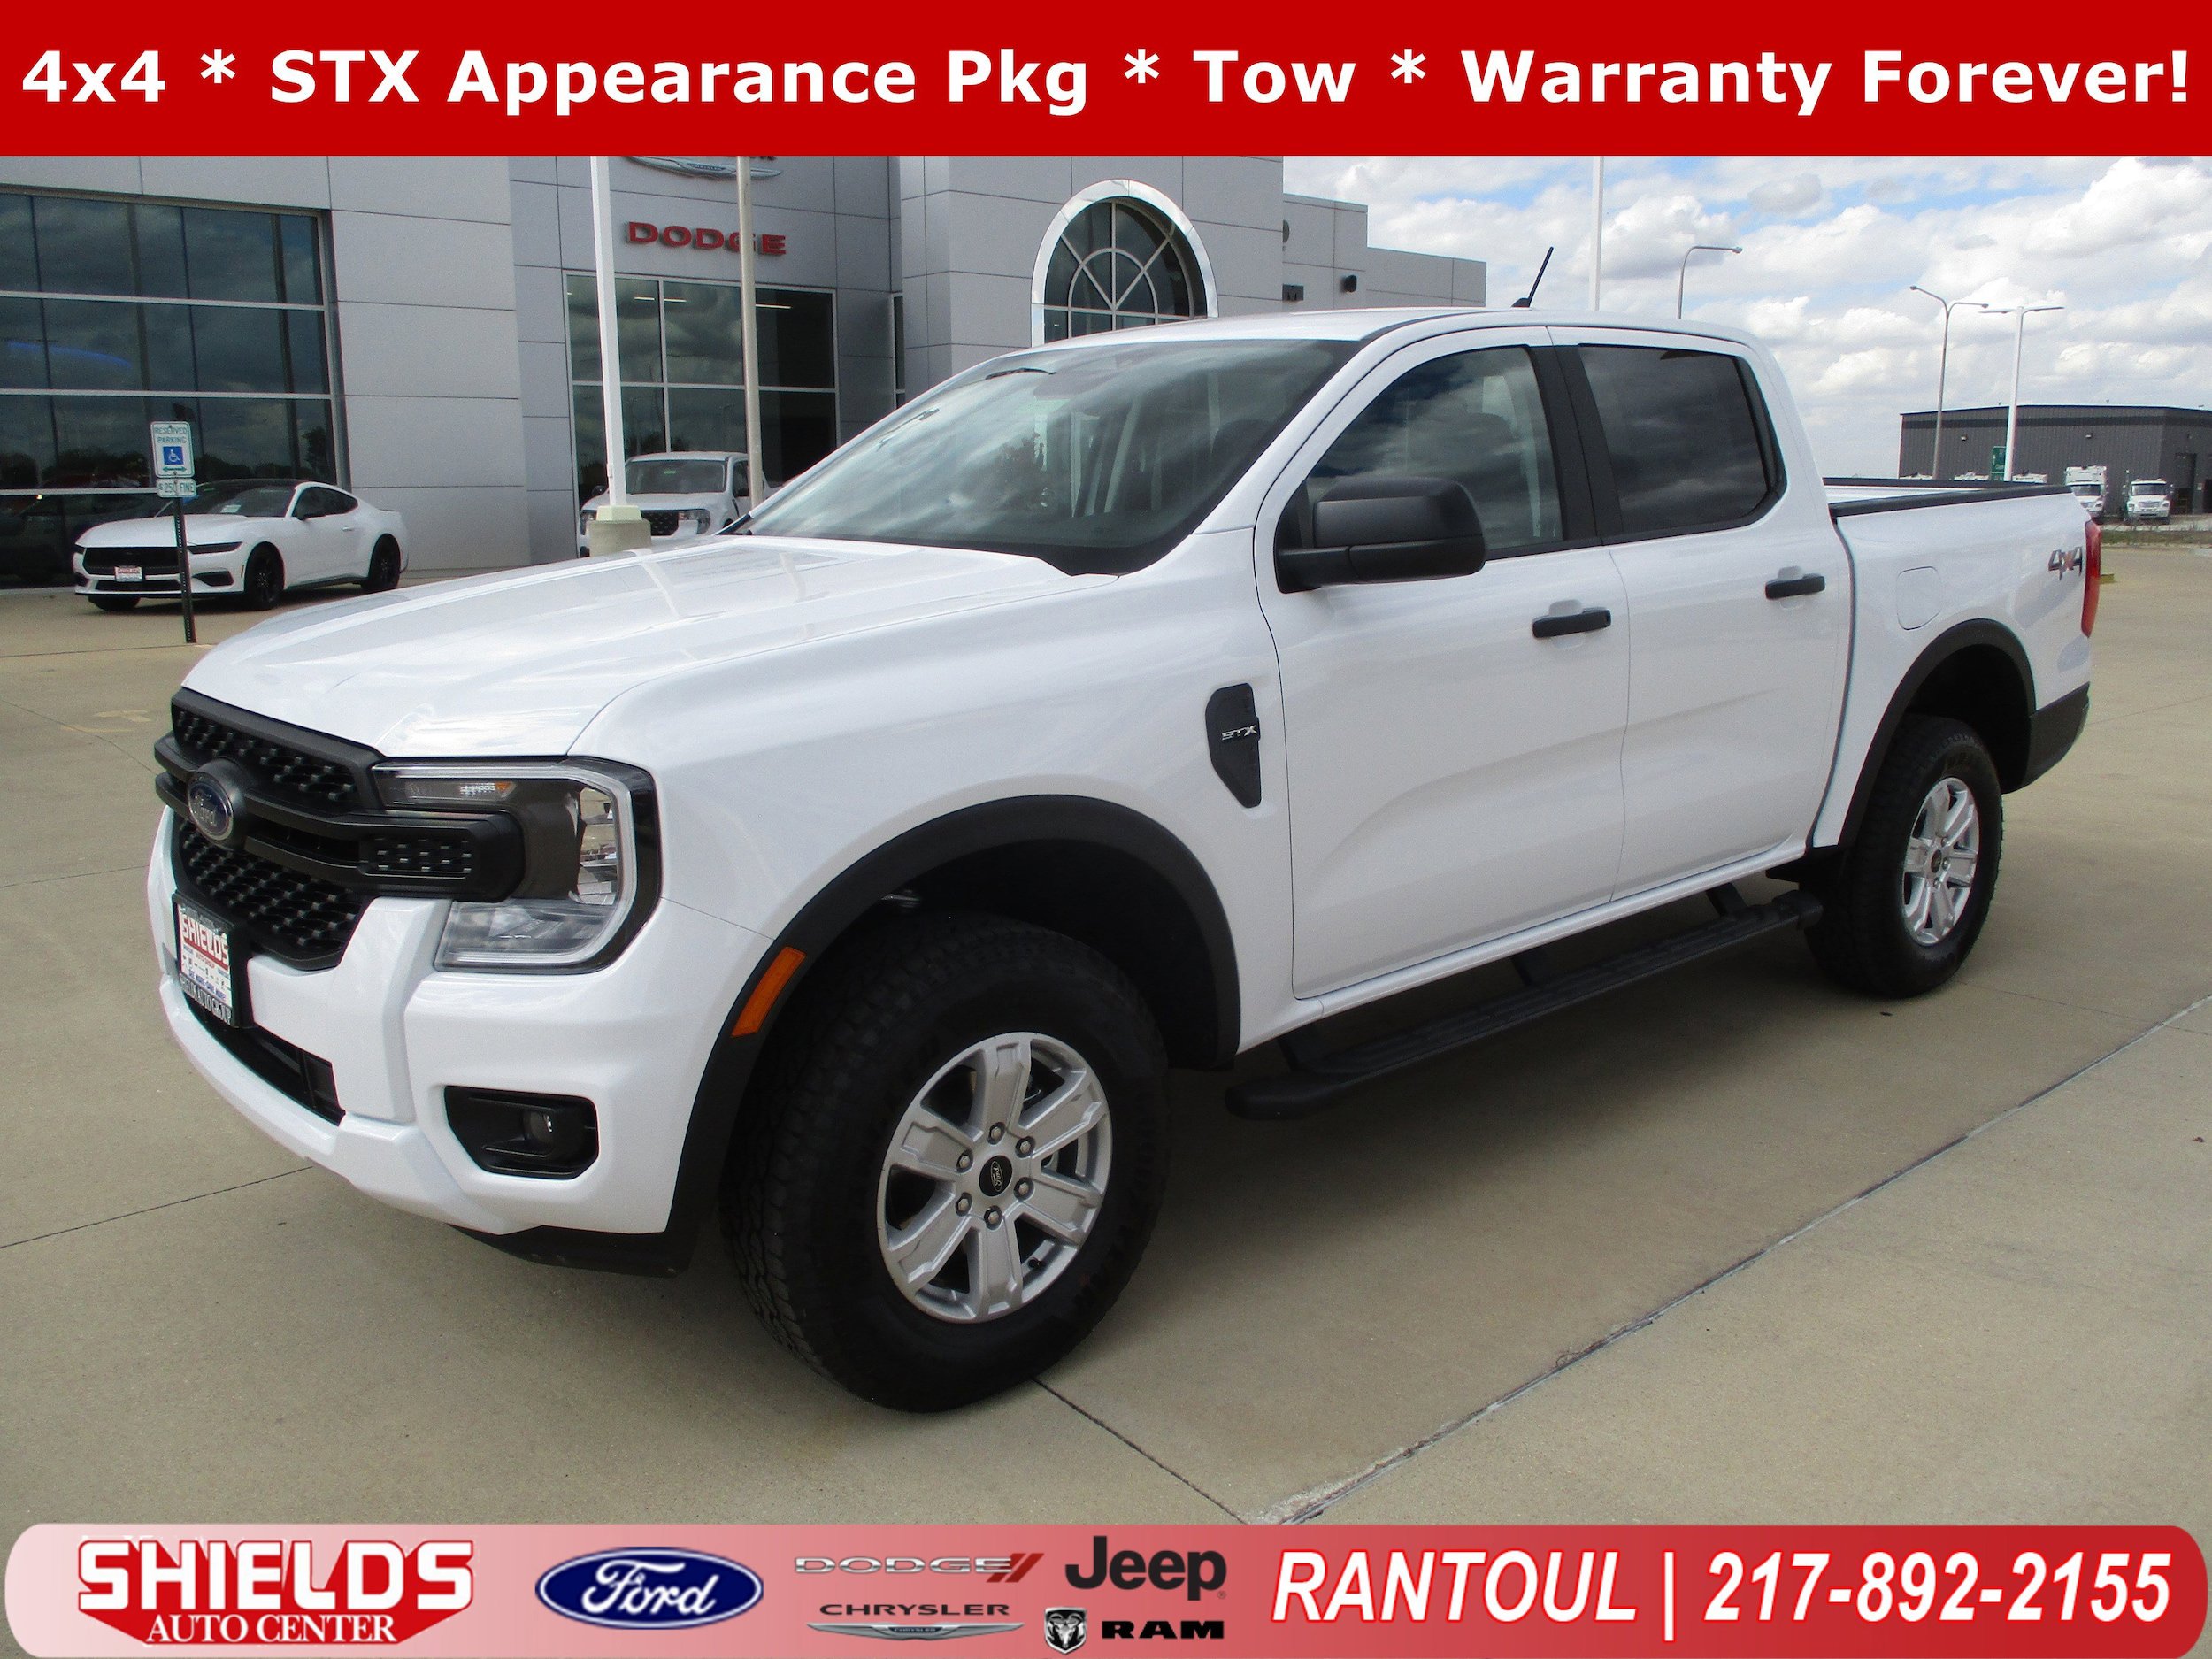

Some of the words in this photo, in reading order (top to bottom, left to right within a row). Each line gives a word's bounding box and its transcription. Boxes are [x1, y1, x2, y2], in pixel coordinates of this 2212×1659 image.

[1221, 725, 1257, 741] STX
[181, 914, 230, 966] SHIELDS
[992, 1167, 1002, 1187] Ford
